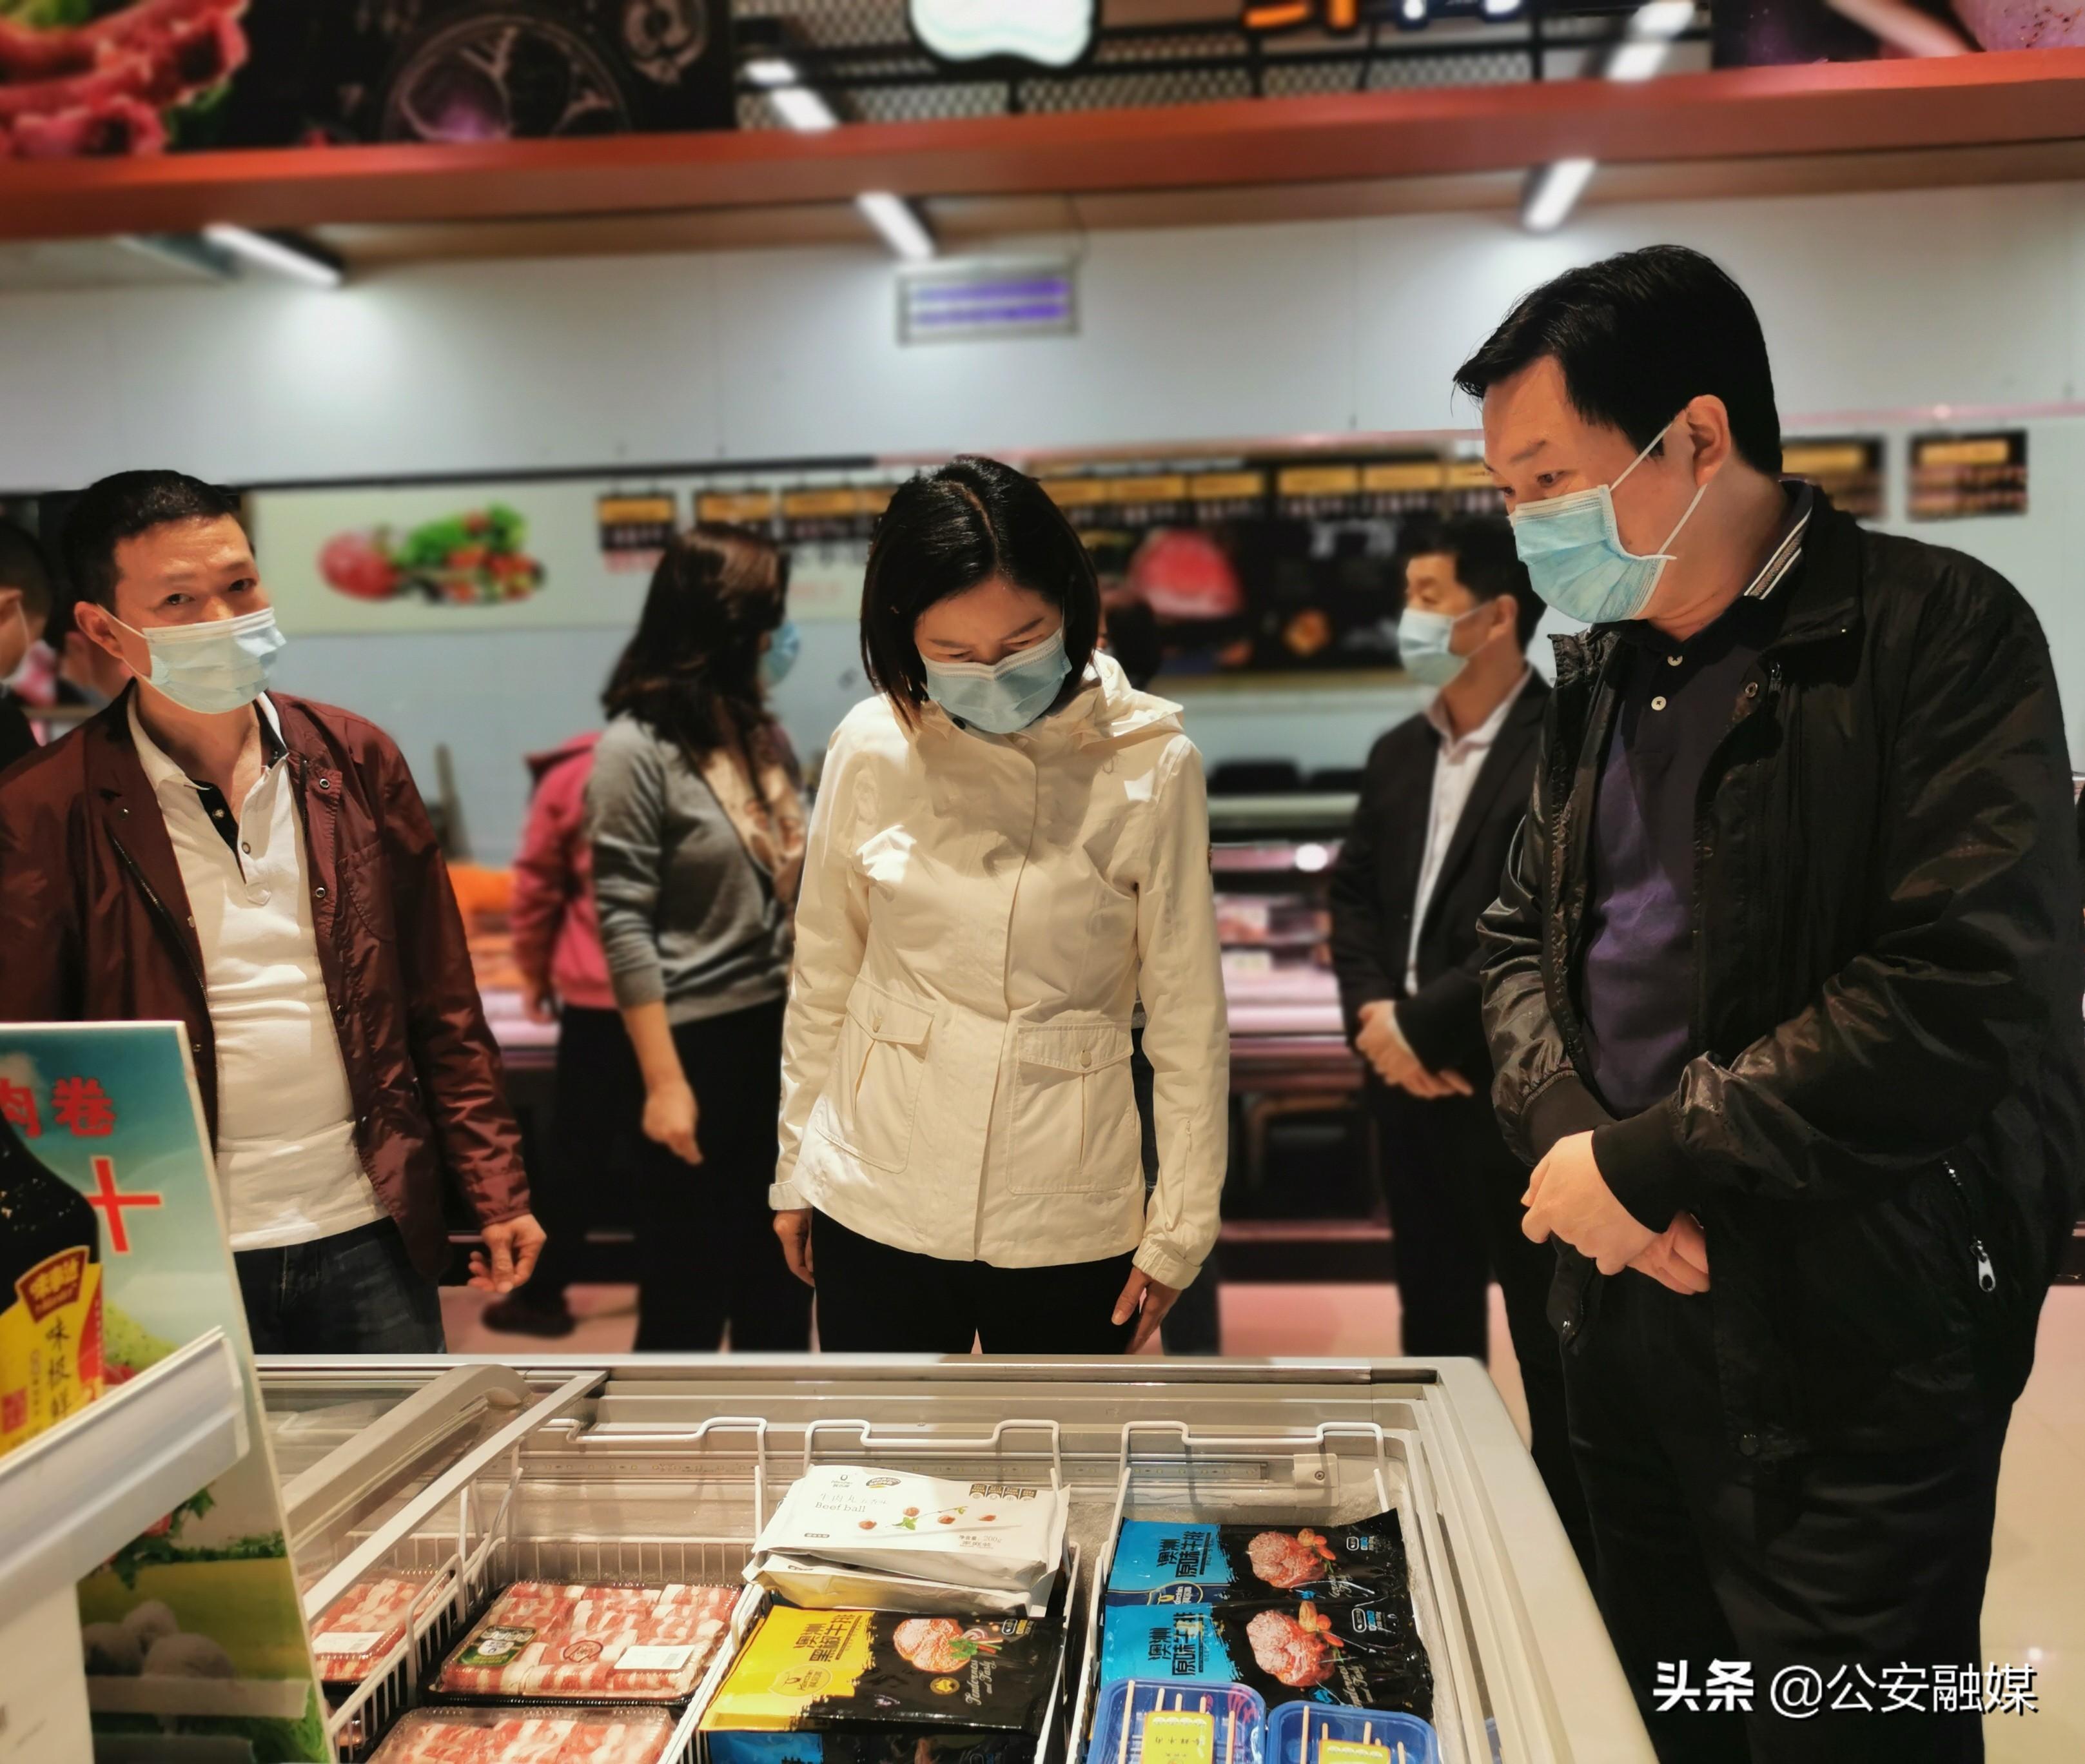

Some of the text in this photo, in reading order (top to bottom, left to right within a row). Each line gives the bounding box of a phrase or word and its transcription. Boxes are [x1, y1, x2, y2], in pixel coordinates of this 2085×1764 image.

[815, 1502, 840, 1511] Beef
[1157, 1539, 1180, 1567] 澳洲
[1175, 1531, 1204, 1578] 原味牛排
[793, 1623, 827, 1649] 澳洲
[808, 1614, 855, 1661] 黑椒牛排
[1148, 1627, 1171, 1661] 澳洲
[1172, 1612, 1197, 1676] 原味牛排
[964, 1660, 982, 1705] Tenderness
[1338, 1665, 1364, 1708] enderness
